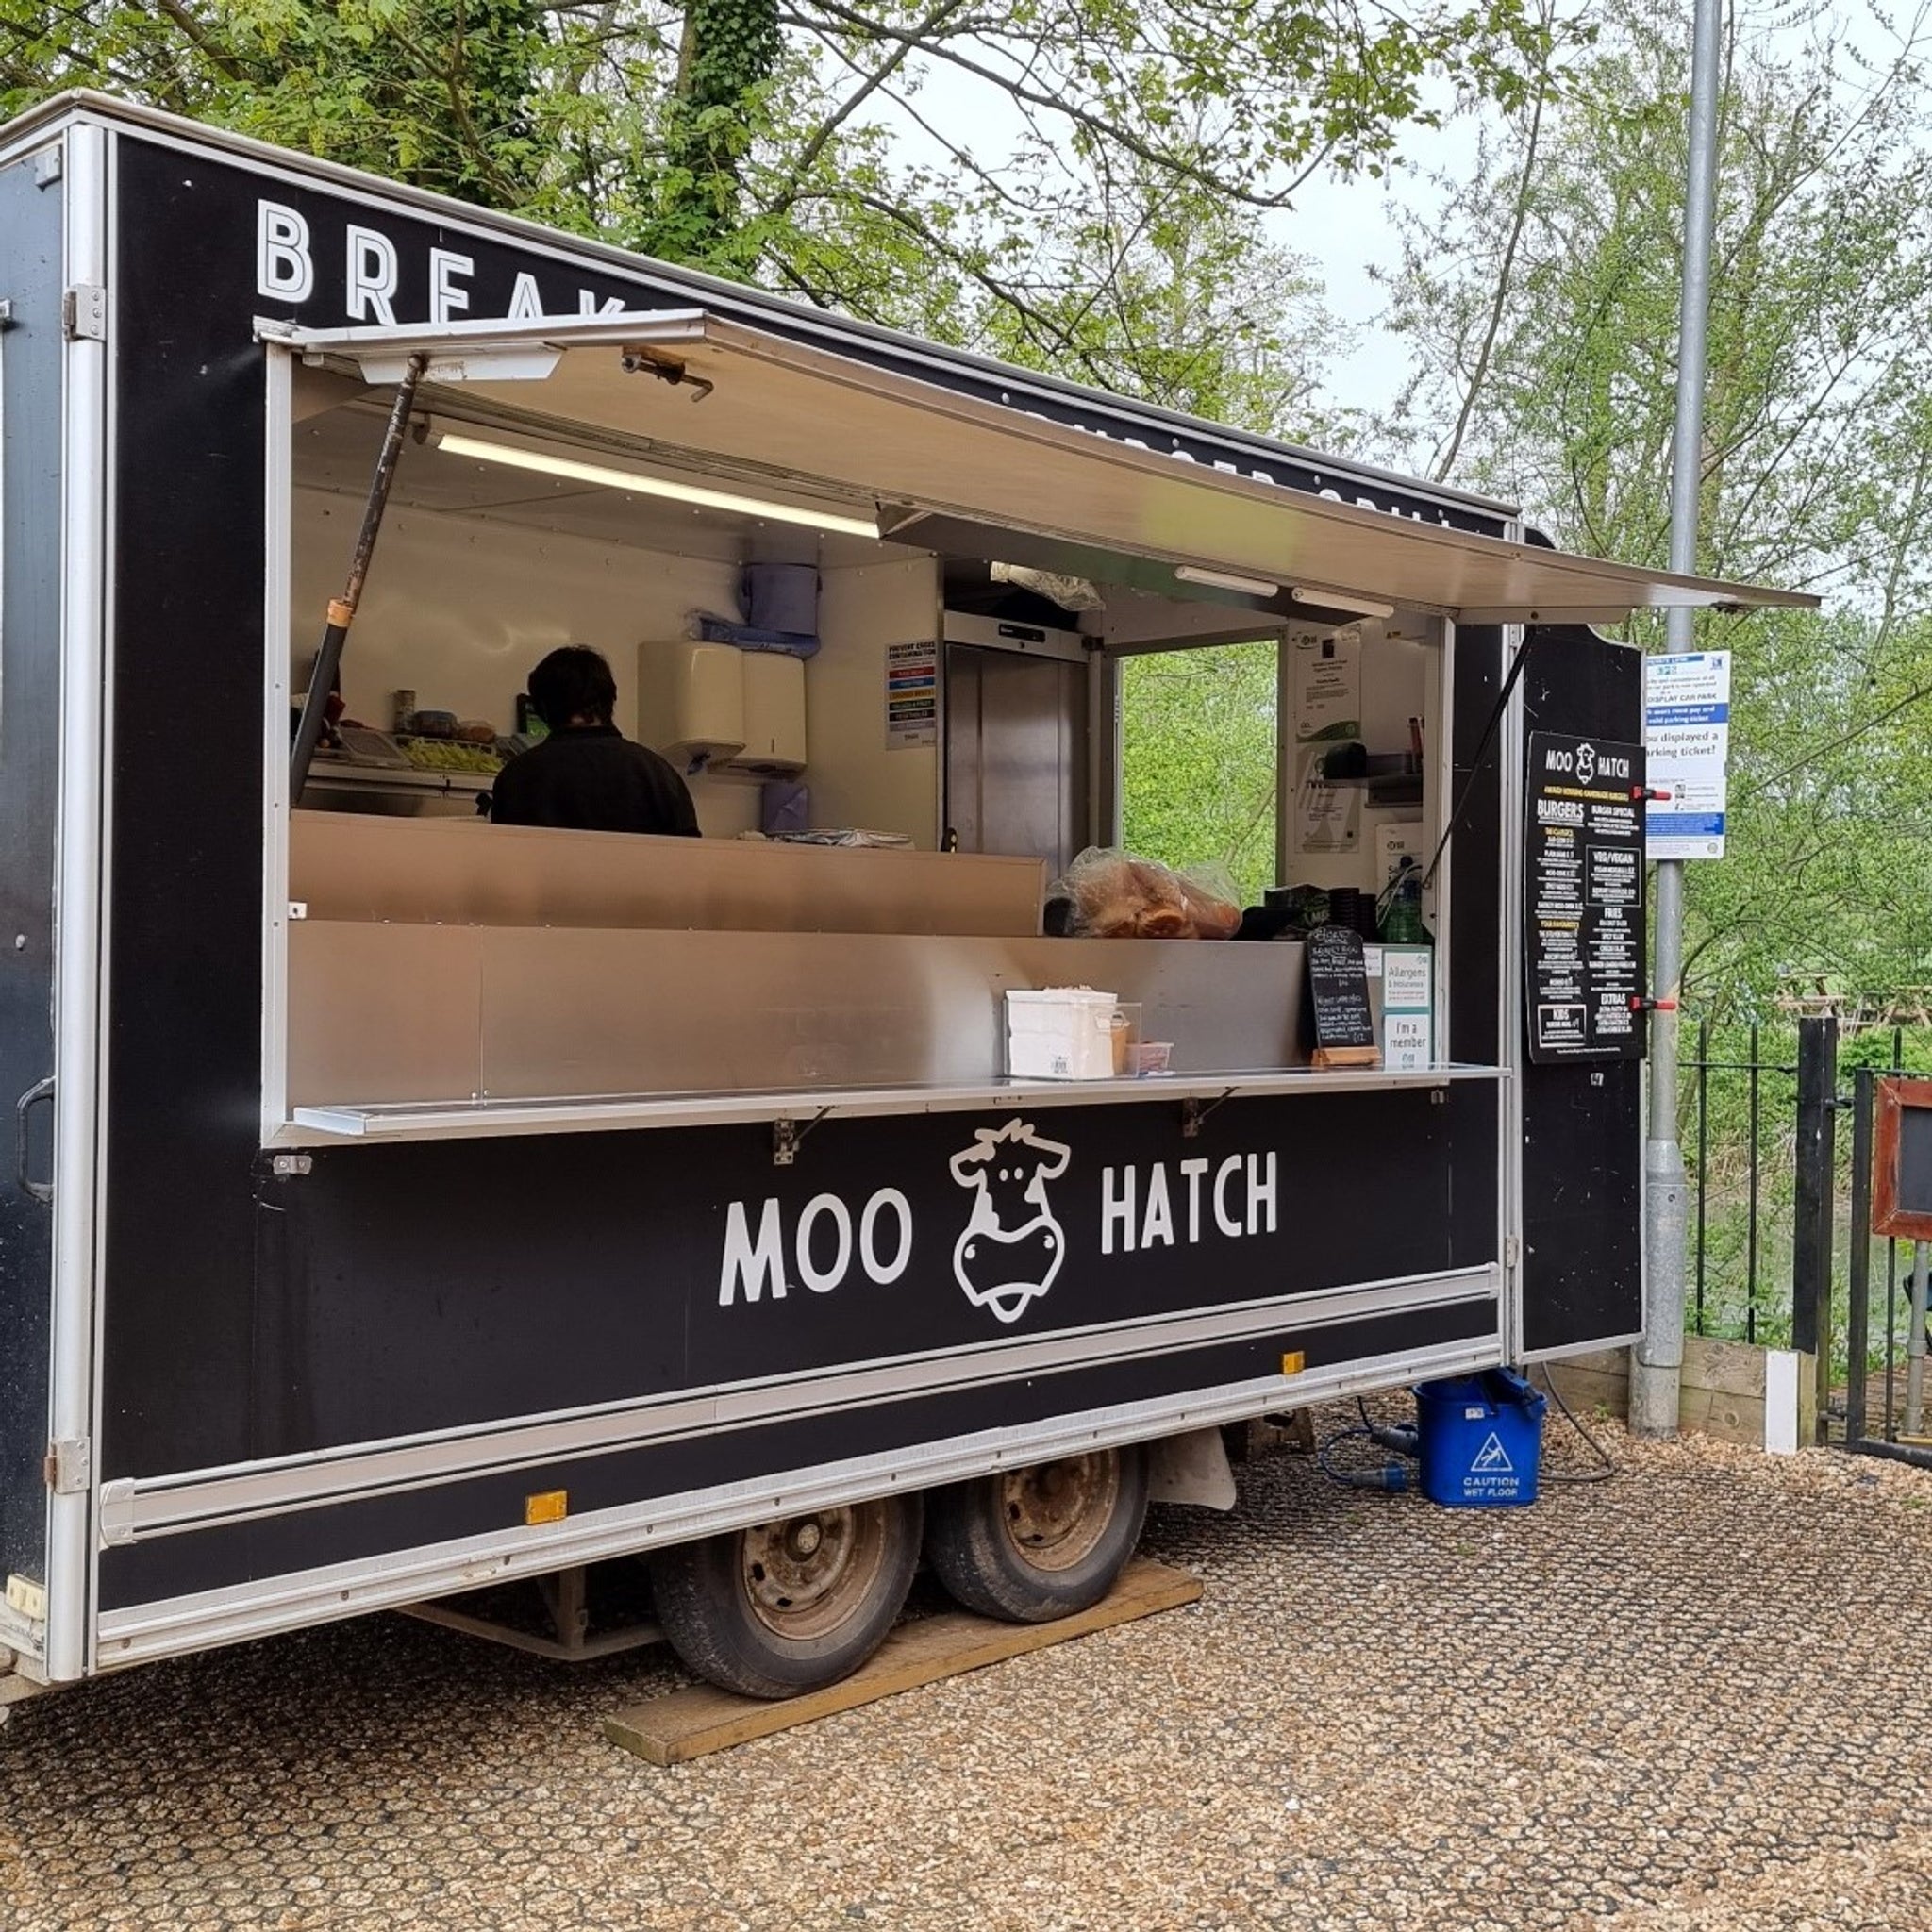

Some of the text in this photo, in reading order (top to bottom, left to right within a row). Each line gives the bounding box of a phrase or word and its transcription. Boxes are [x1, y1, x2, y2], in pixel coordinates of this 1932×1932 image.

[1664, 715, 1690, 724] parking
[1660, 731, 1708, 743] displayed
[1646, 744, 1716, 758] arking ticket!
[1545, 749, 1630, 778] MOO HATCH
[1537, 799, 1585, 818] BURGERS
[1592, 851, 1635, 864] VEG/VEGAN
[1604, 908, 1623, 919] FRIES
[1388, 966, 1426, 980] Allergens
[1601, 993, 1626, 1005] EXTRAS
[1396, 1021, 1410, 1034] I'm
[1390, 1037, 1426, 1049] member
[719, 1151, 1277, 1306] MOO HATCH
[1463, 1476, 1520, 1486] CAUTION
[1463, 1488, 1518, 1497] WET FLOOR
